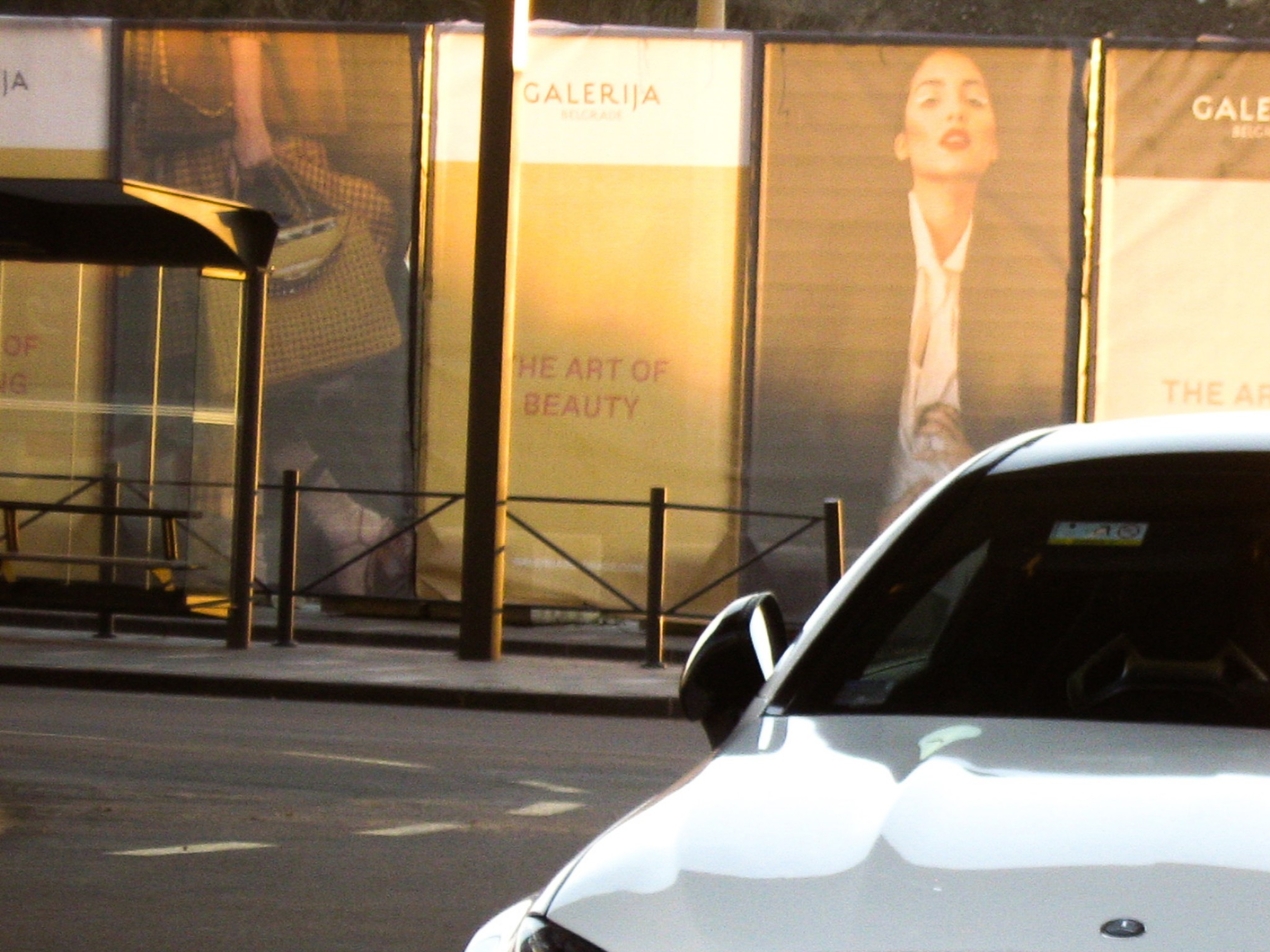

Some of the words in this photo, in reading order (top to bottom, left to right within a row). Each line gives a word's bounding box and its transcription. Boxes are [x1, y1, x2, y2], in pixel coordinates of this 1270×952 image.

[523, 82, 661, 112] GALERIJA
[518, 355, 557, 379] HE
[565, 356, 624, 381] ART
[631, 358, 671, 382] OF
[524, 391, 640, 419] BEAUTY
[1162, 379, 1225, 406] THE
